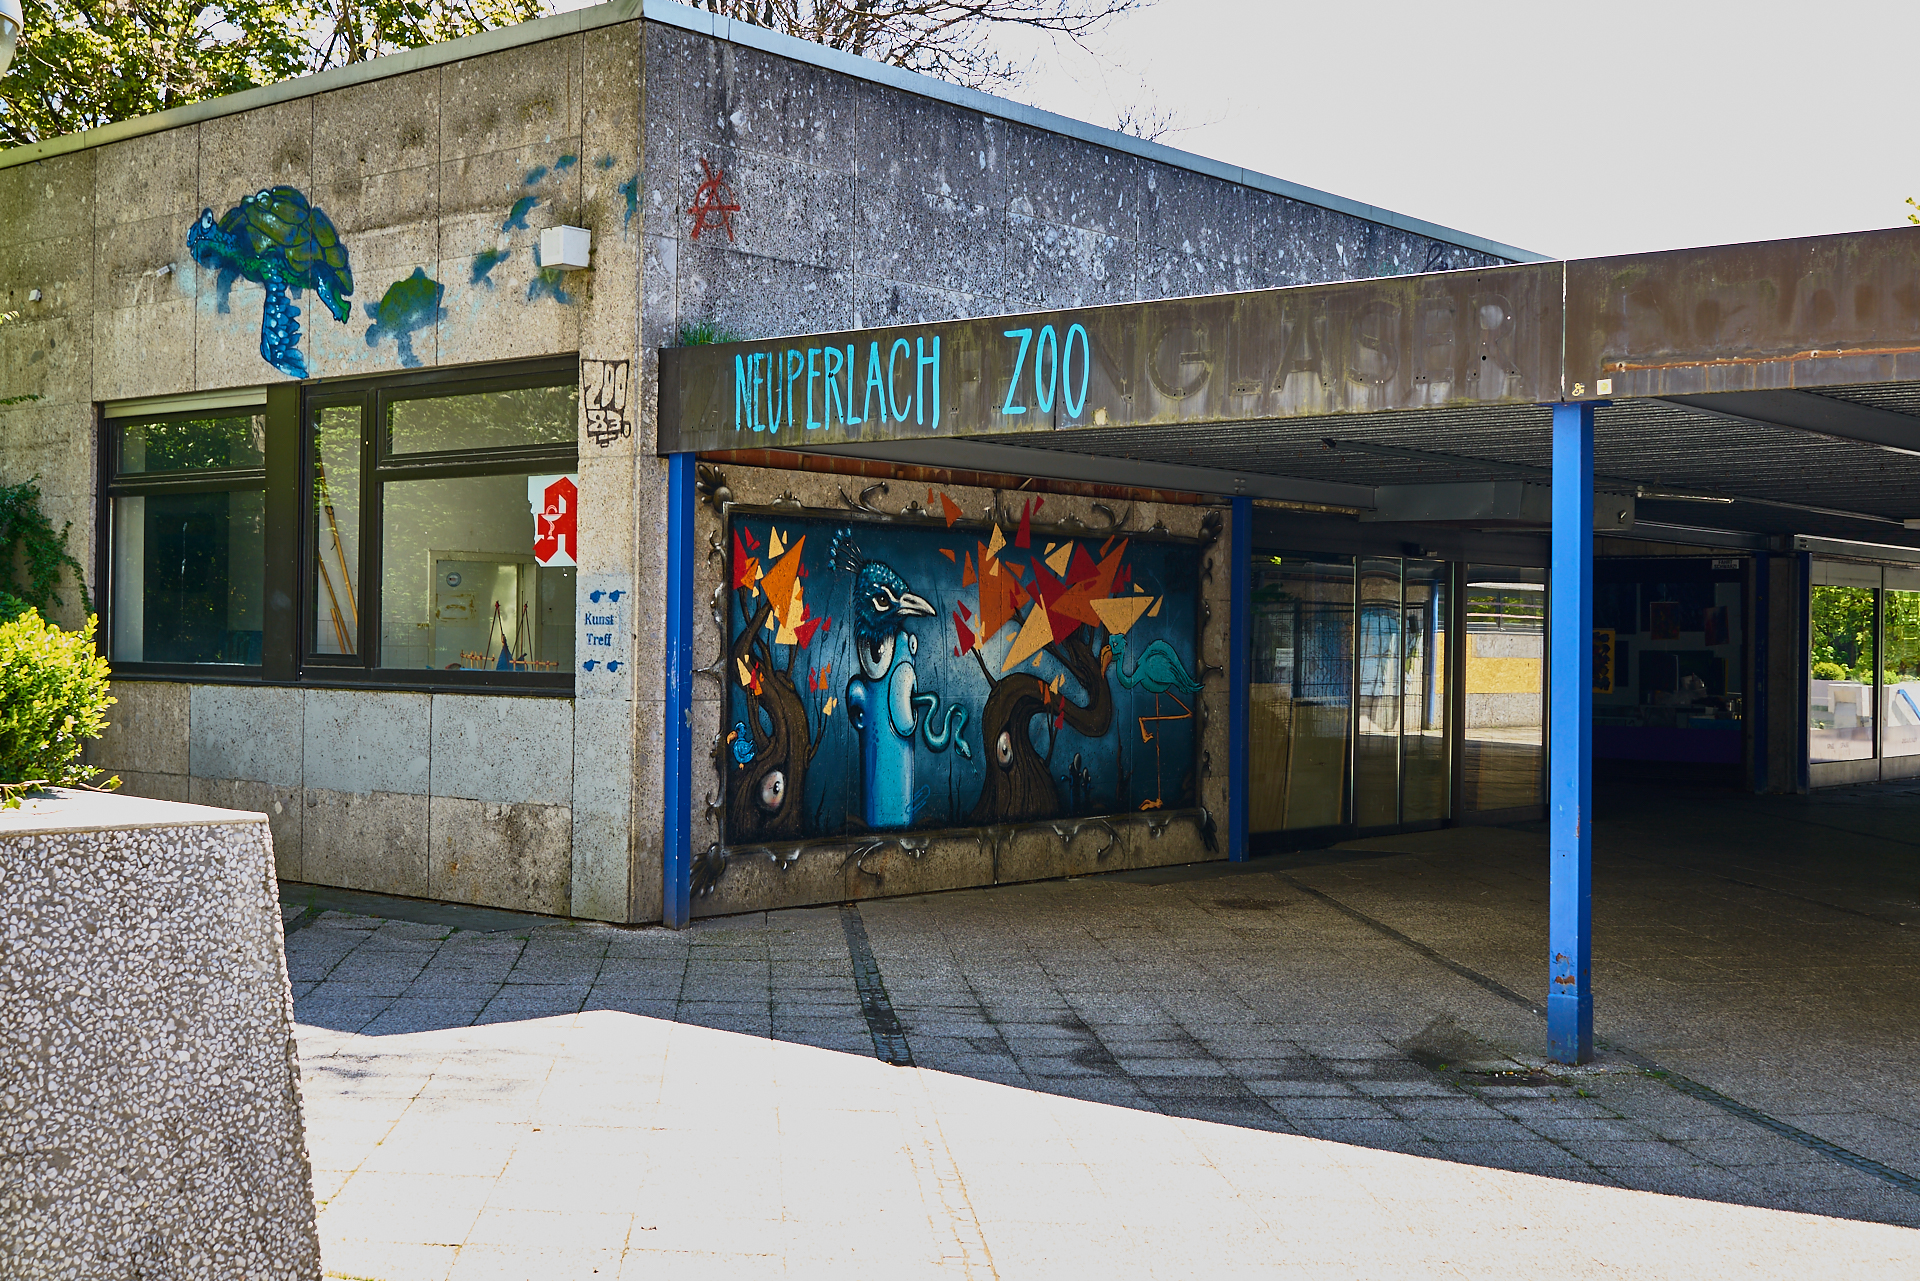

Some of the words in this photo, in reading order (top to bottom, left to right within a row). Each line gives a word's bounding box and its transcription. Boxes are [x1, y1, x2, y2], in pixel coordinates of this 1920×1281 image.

[734, 335, 940, 434] NEUPERLACH
[1002, 323, 1090, 418] ZOO
[585, 612, 614, 625] Kunst
[586, 633, 612, 646] Treff
